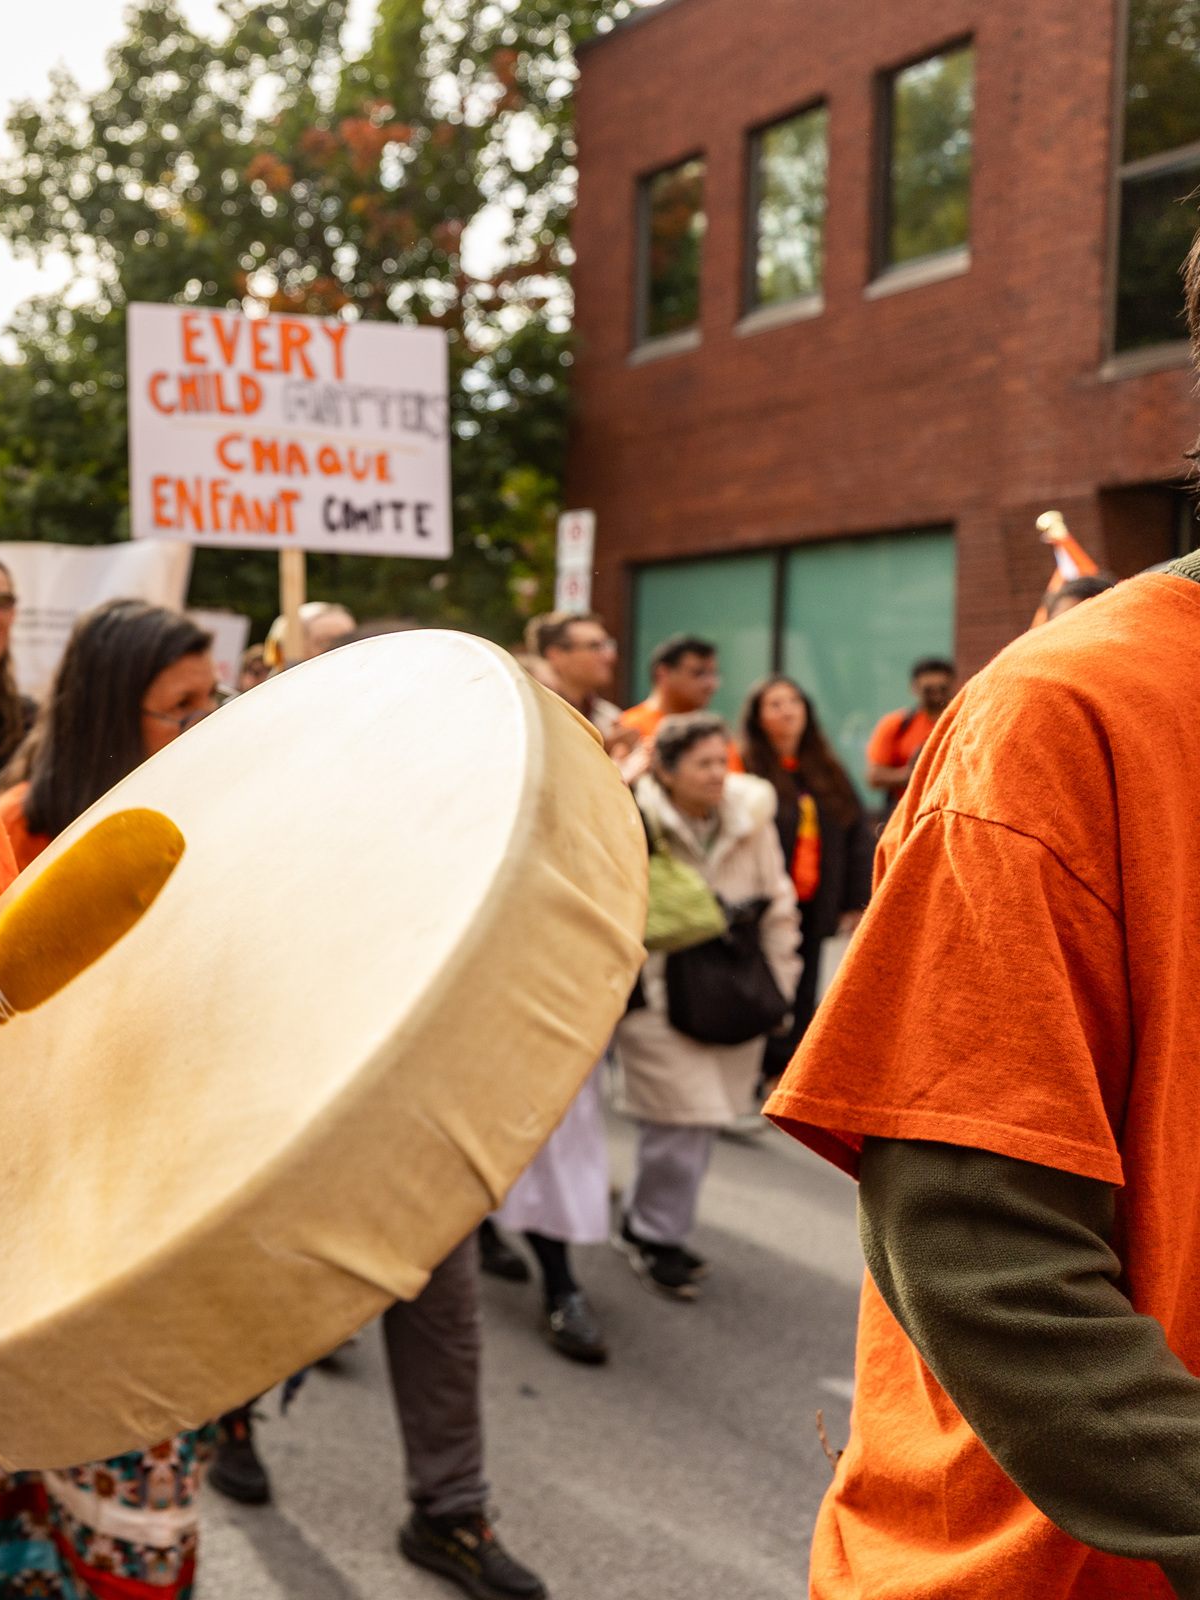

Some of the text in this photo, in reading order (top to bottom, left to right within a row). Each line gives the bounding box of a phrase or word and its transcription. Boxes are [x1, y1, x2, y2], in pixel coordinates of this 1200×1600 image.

[180, 310, 348, 381] EVERY
[148, 371, 263, 416] CHILD
[215, 432, 395, 484] CHAQUE
[151, 475, 302, 536] ENFANT
